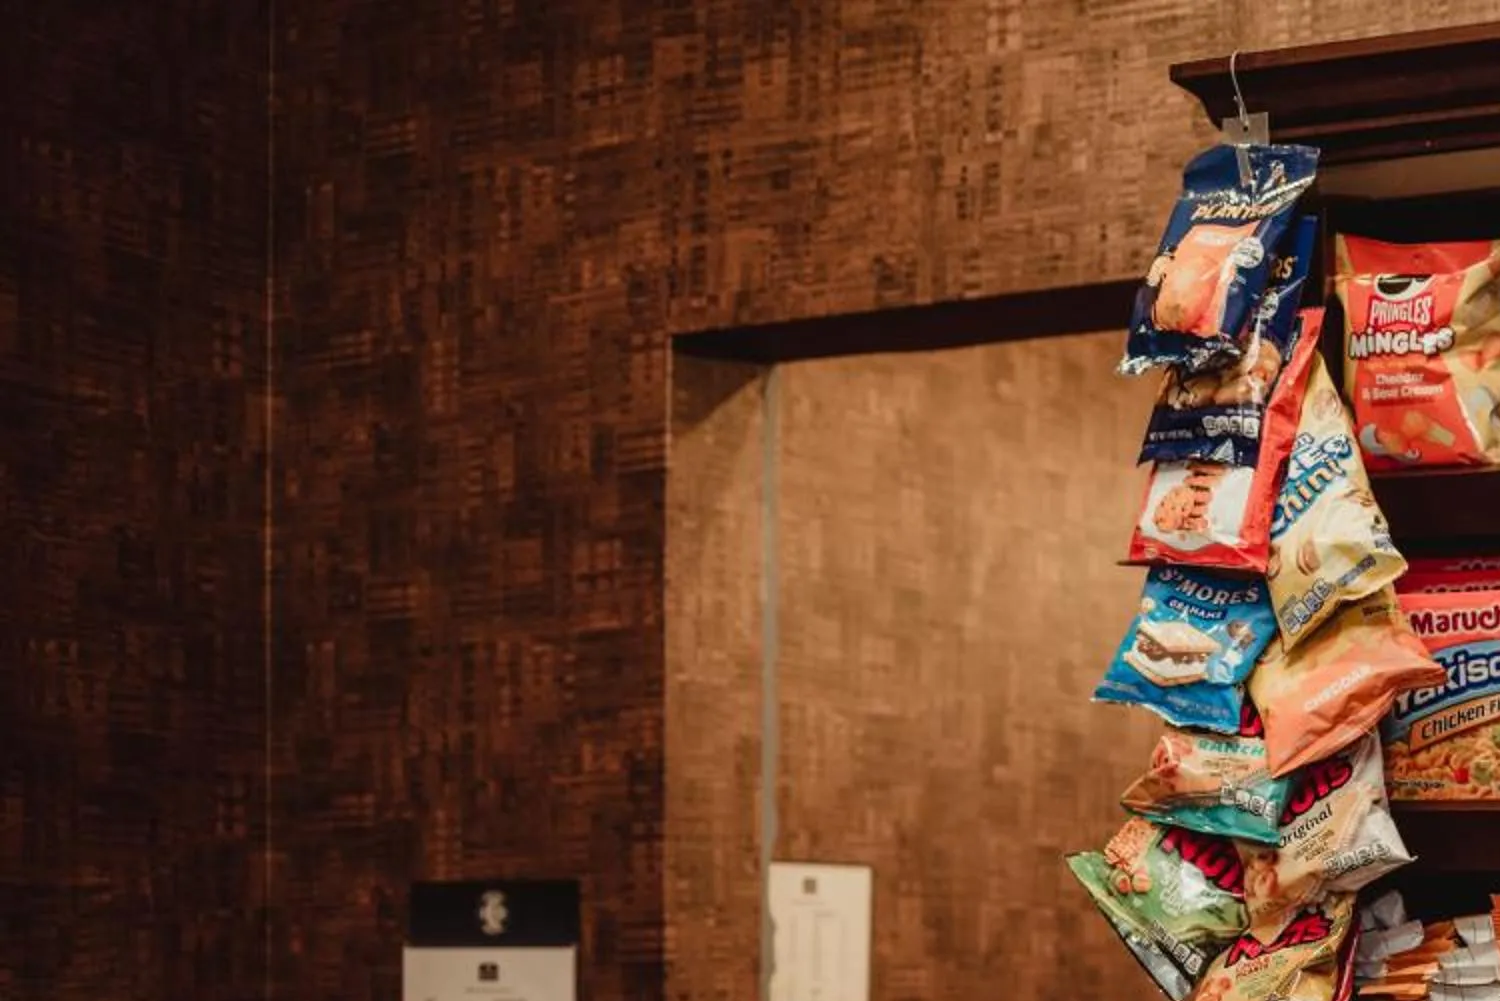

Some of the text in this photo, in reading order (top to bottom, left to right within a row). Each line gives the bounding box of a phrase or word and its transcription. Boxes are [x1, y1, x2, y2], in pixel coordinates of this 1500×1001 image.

[1370, 296, 1432, 326] PRINGLES
[1158, 569, 1260, 605] S'MORES
[1420, 705, 1486, 740] Chicken
[1279, 803, 1334, 849] Original
